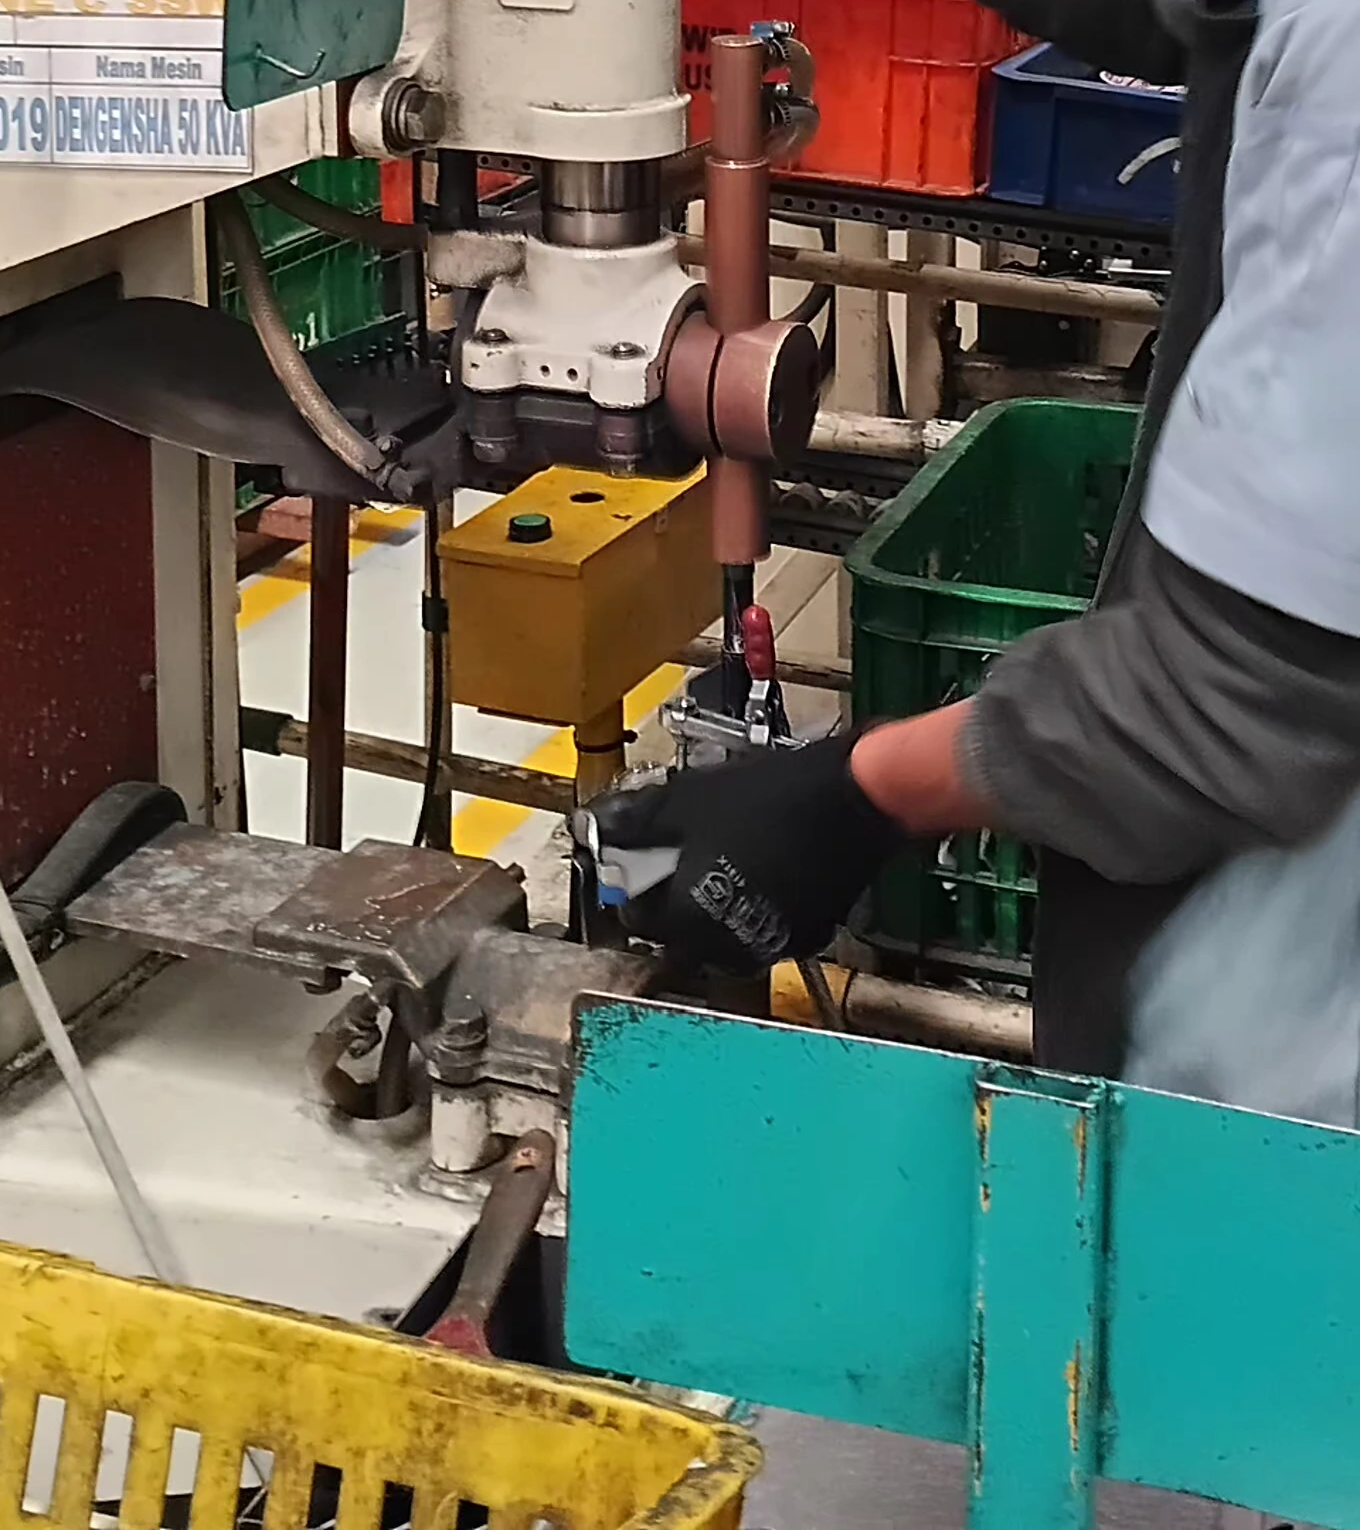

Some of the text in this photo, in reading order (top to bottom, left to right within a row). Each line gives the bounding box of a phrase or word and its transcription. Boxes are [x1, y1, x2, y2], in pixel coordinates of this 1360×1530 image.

[96, 55, 145, 78] Nama
[151, 56, 202, 80] Mesin
[55, 96, 173, 155] DENGENSHA
[178, 99, 201, 155] 50
[206, 99, 246, 156] KVA
